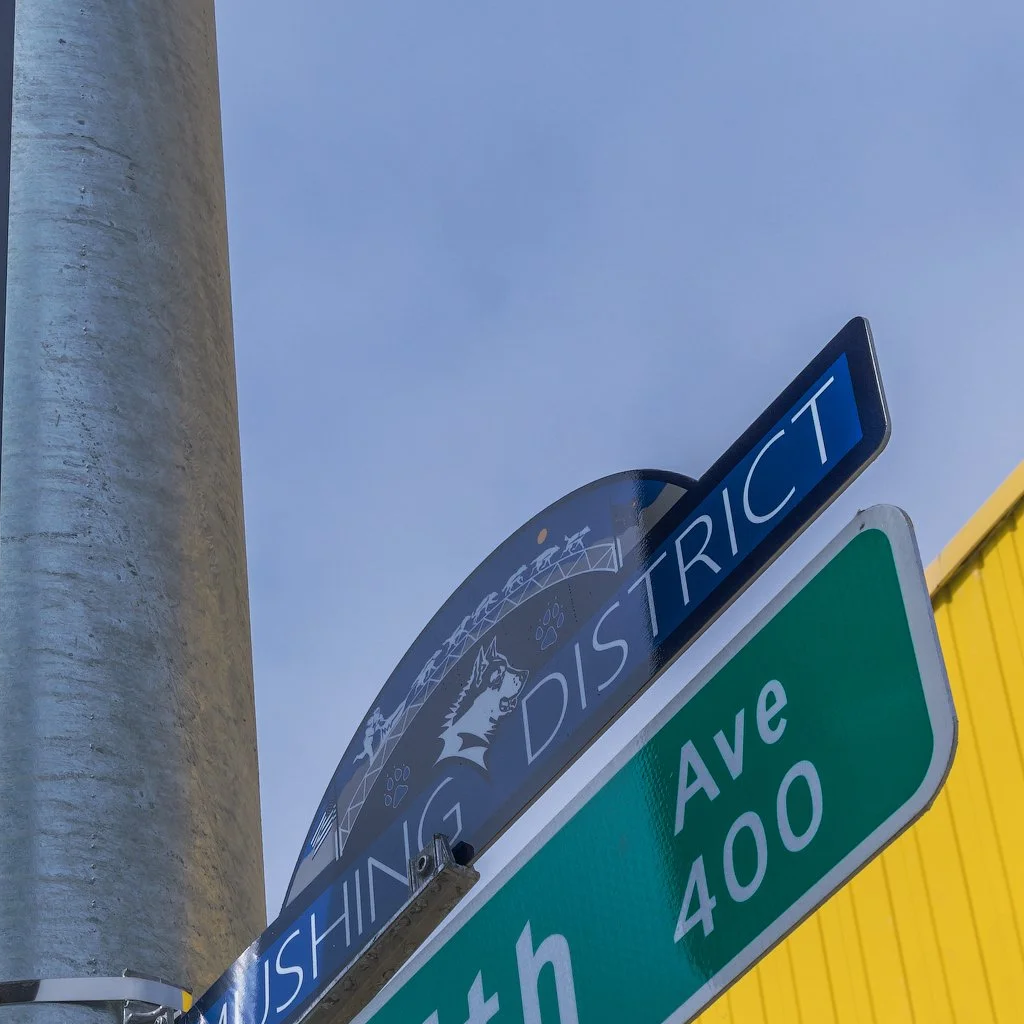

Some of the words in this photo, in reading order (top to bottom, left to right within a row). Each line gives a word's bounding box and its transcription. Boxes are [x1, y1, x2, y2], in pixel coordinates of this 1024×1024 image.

[521, 377, 835, 766] DISTRICT
[674, 679, 789, 834] Ave
[674, 760, 824, 944] 400
